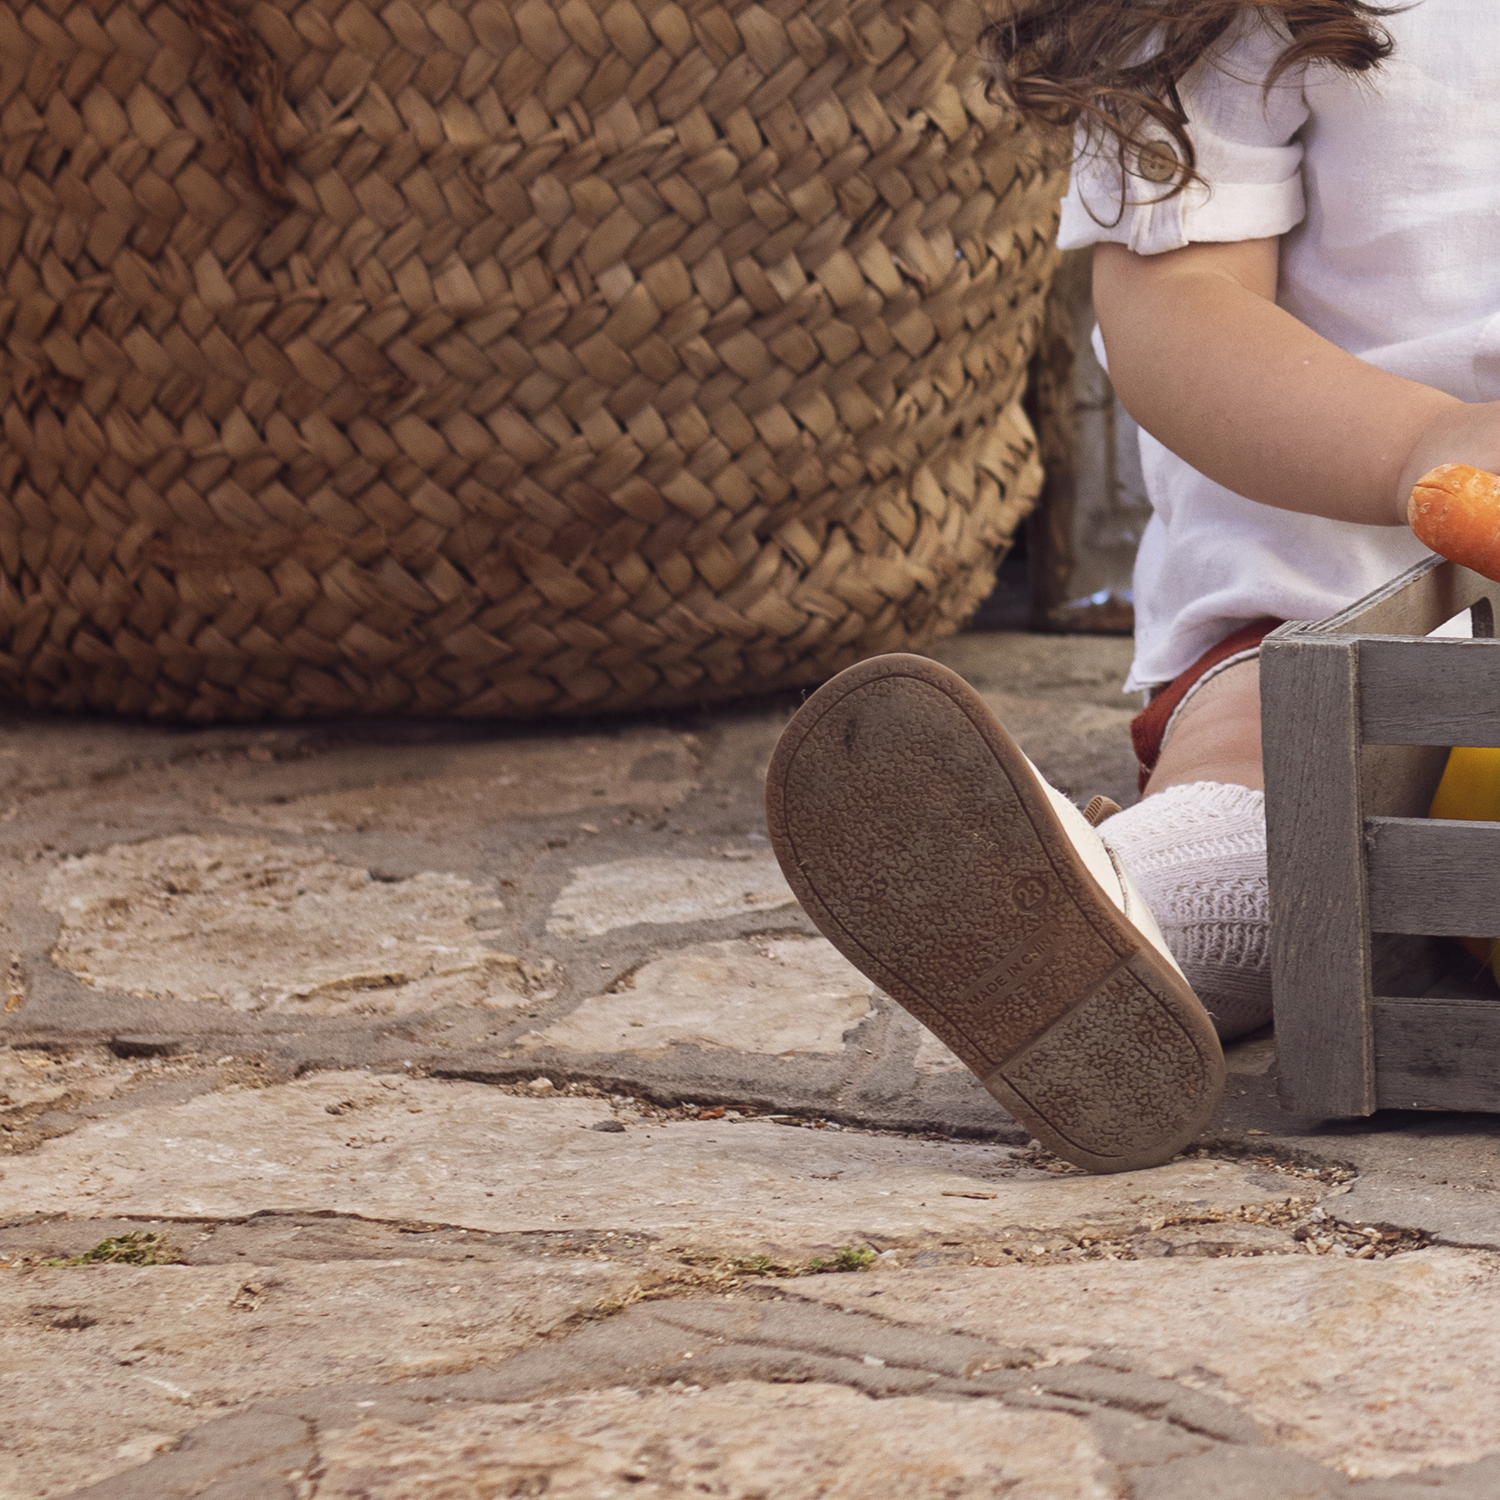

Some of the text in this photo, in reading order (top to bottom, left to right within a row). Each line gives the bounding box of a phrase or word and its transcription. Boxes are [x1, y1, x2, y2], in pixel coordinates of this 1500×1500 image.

[1018, 880, 1045, 909] 23
[966, 975, 1008, 1008] MADE
[1006, 961, 1023, 979] IN
